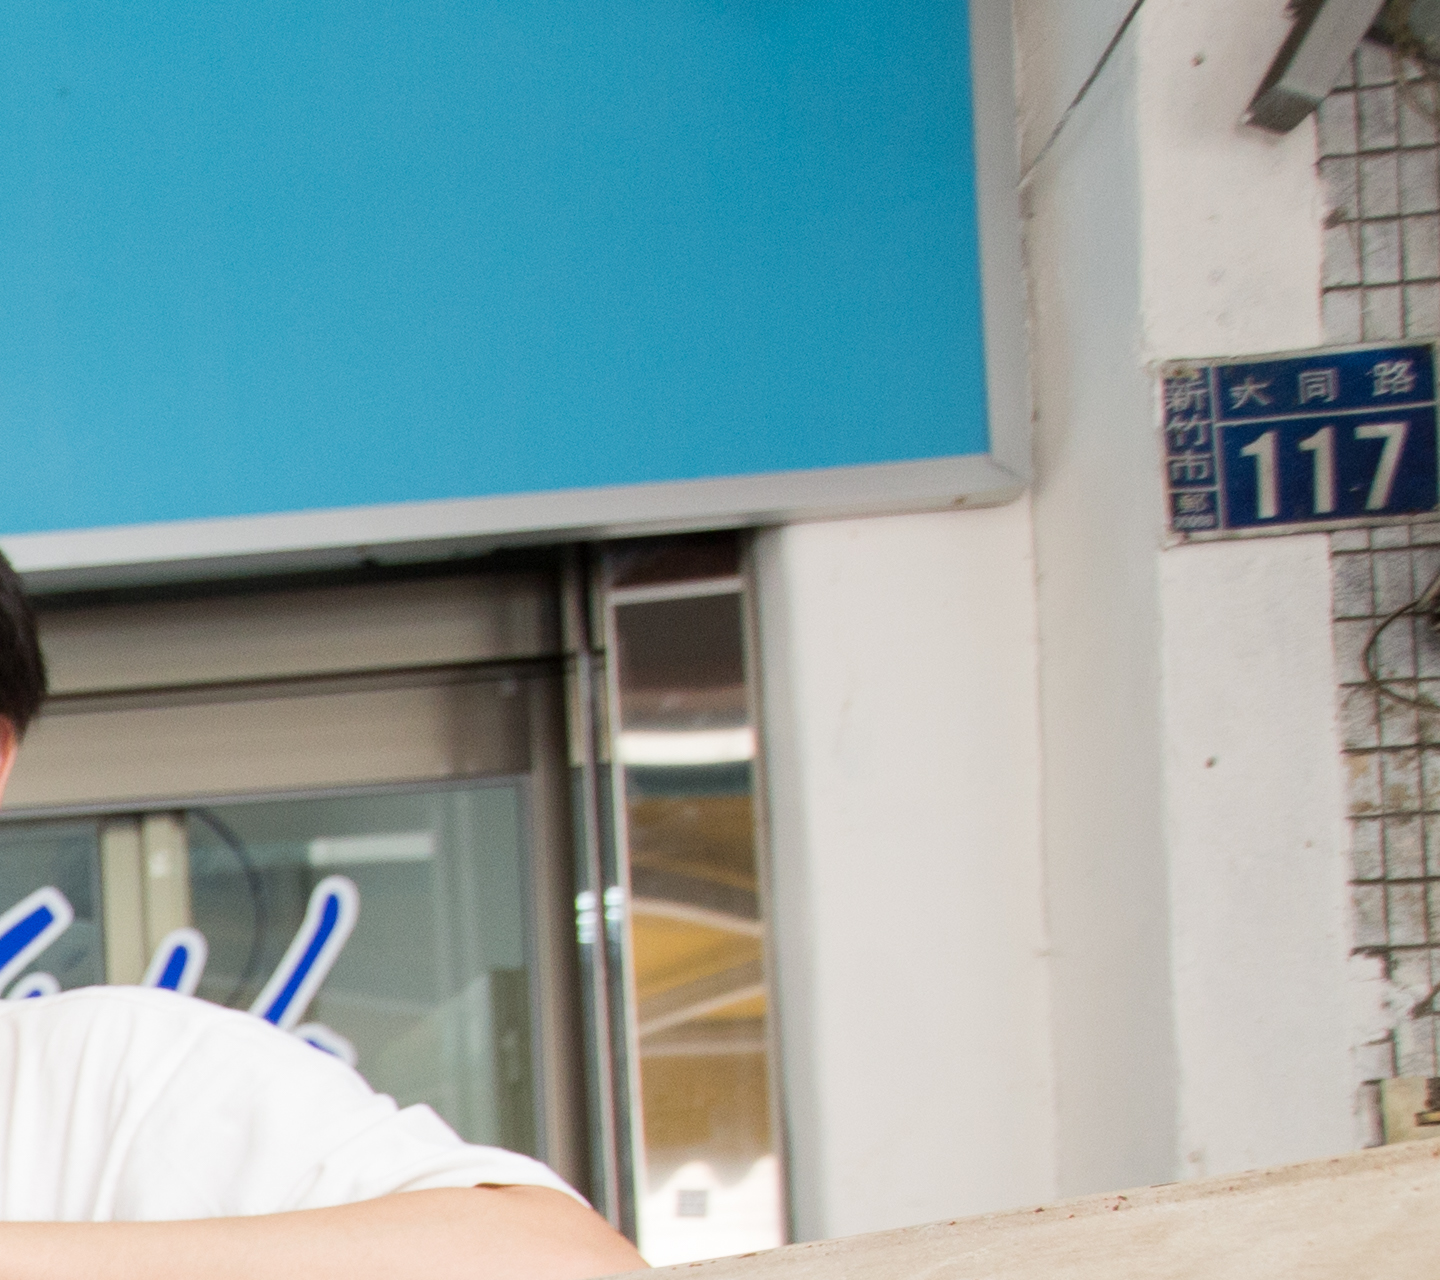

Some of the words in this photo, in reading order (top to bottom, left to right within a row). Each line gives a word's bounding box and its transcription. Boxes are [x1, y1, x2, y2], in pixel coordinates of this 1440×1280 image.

[1164, 374, 1214, 481] 新竹市
[1230, 359, 1418, 410] 大同路
[1241, 420, 1408, 520] 117
